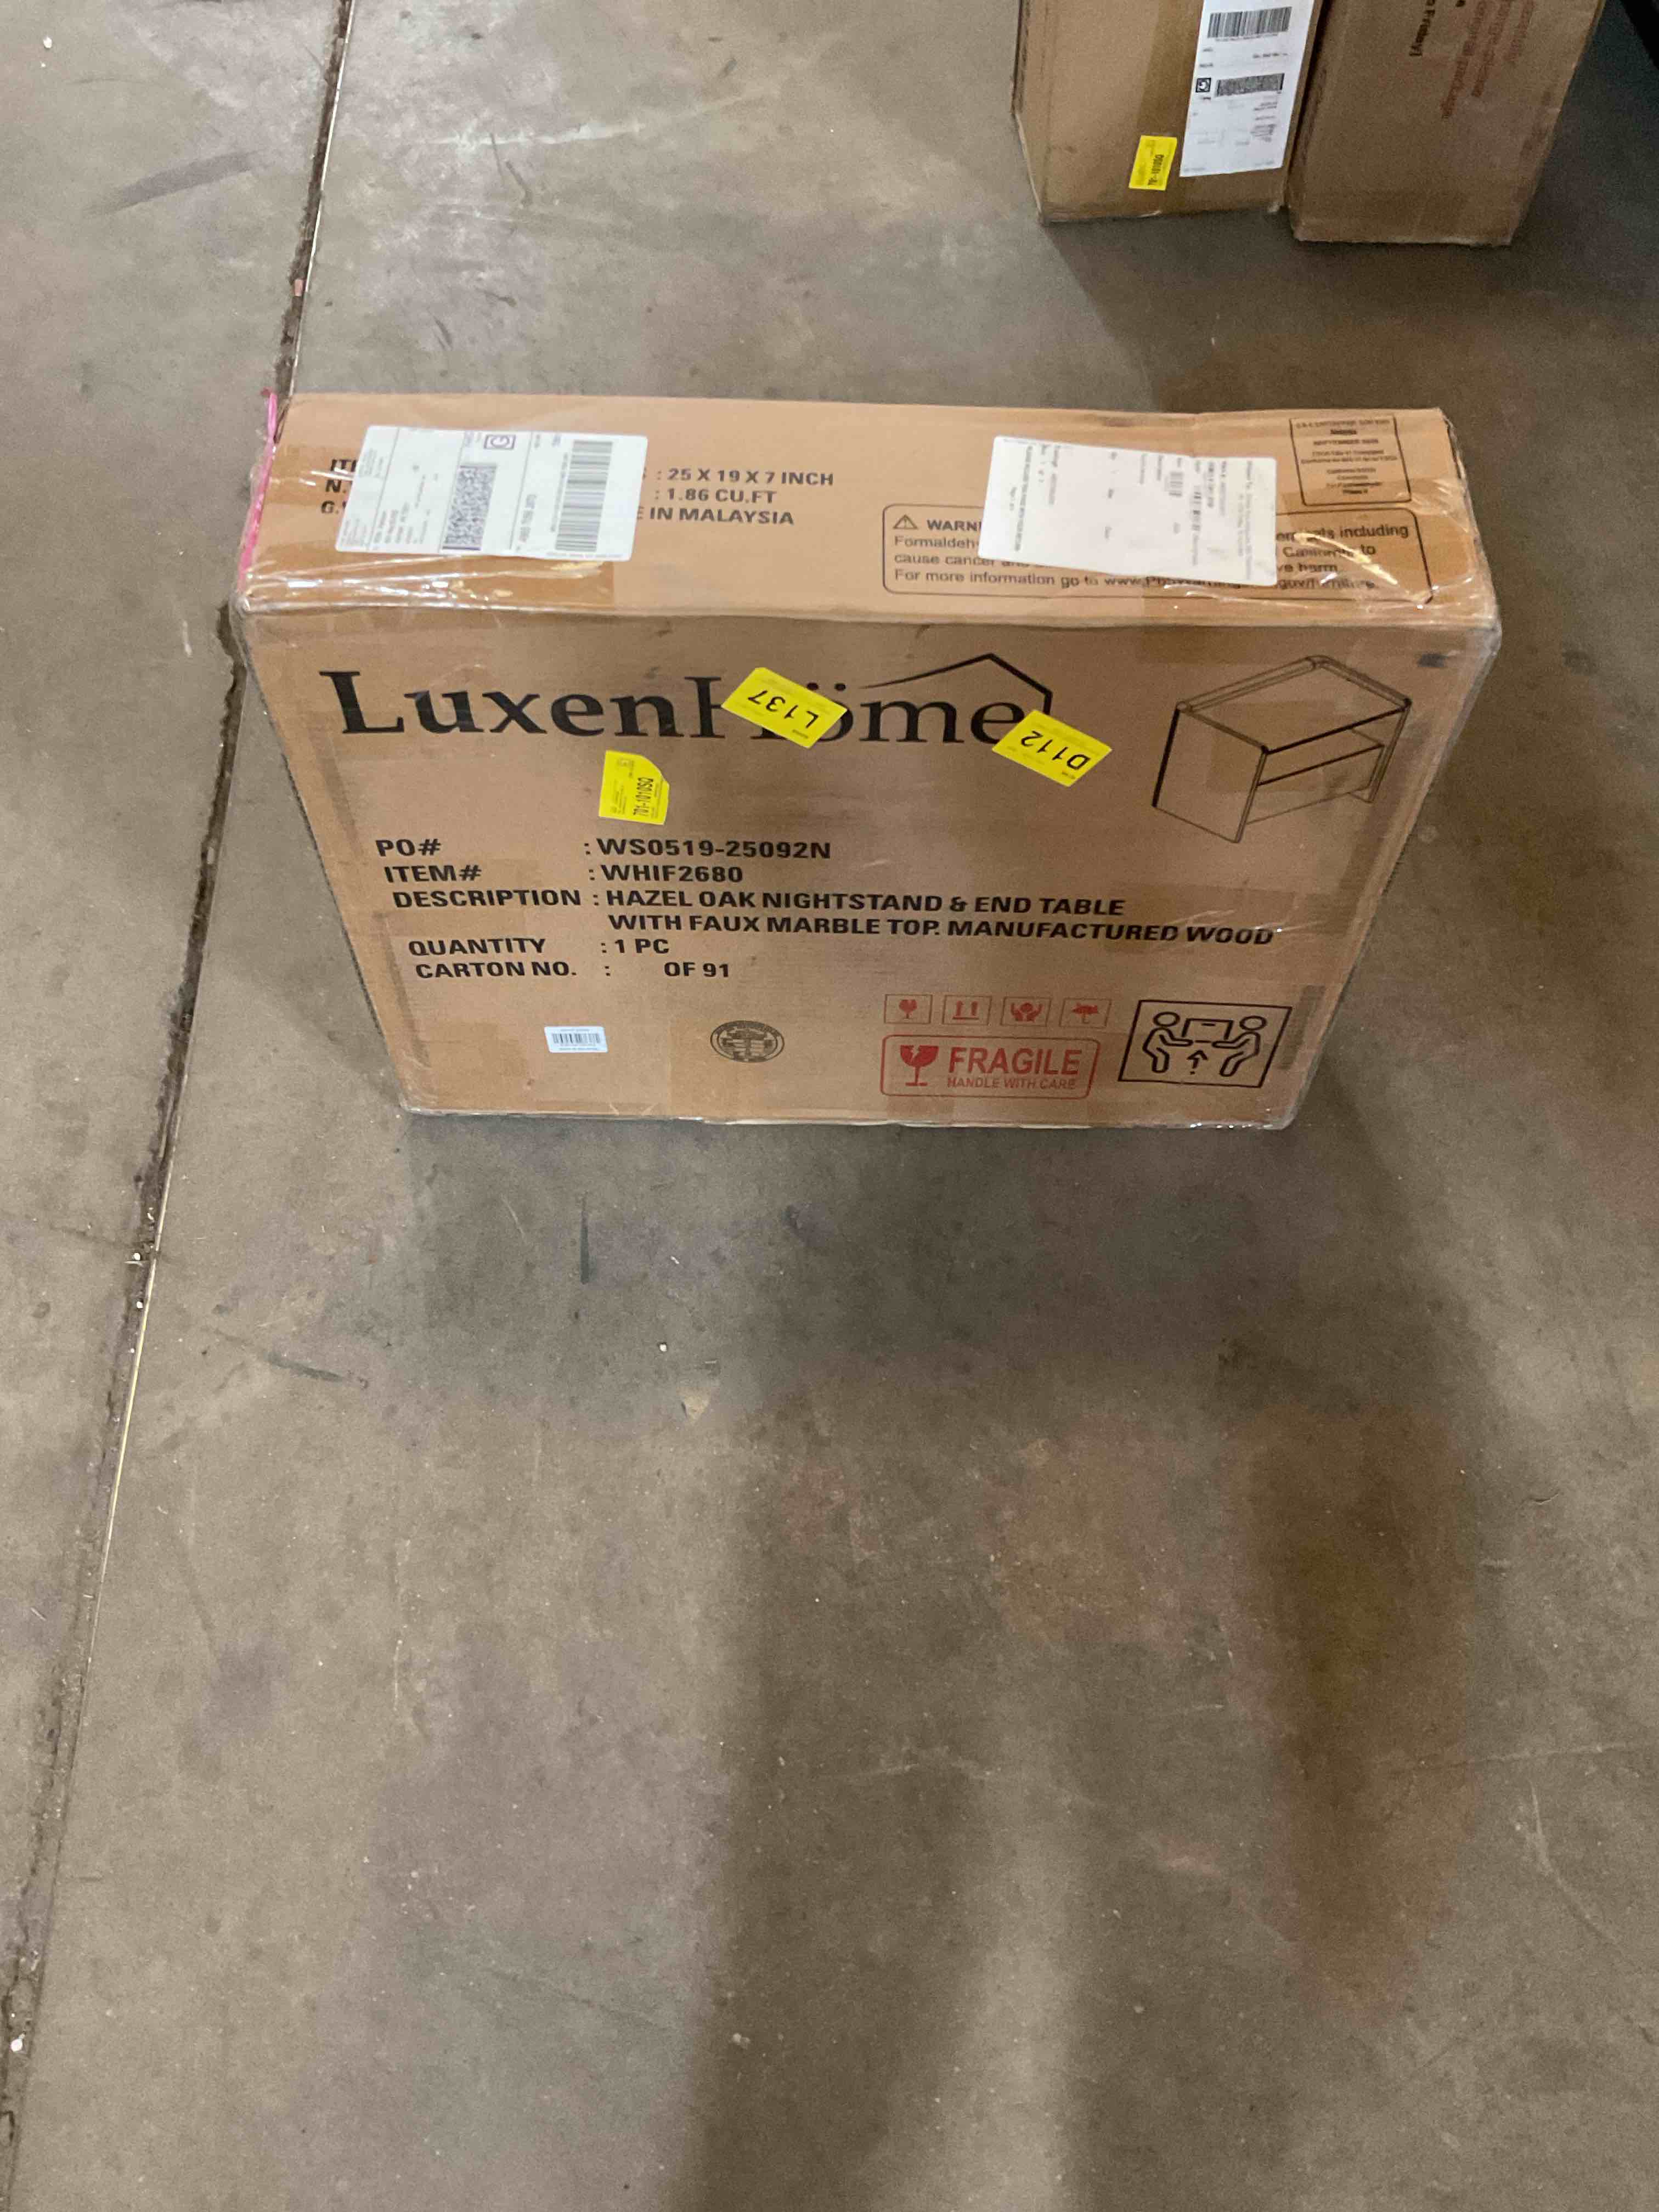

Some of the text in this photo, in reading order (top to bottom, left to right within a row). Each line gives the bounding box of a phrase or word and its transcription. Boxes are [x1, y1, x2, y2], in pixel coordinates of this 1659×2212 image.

[667, 468, 691, 481] 25
[697, 469, 710, 481] X
[718, 470, 740, 483] 19
[746, 470, 759, 483] X
[764, 471, 776, 484] 7
[781, 472, 834, 486] INCH
[667, 488, 709, 501] 1.86
[715, 488, 777, 504] CU.FT
[649, 506, 673, 521] IN
[679, 507, 795, 525] MALAYSIA
[1339, 524, 1409, 538] including
[894, 554, 940, 565] cause
[894, 568, 921, 581] For
[926, 571, 966, 583] more
[970, 571, 1054, 585] information
[1060, 576, 1081, 589] go
[747, 690, 819, 729] L137
[1020, 730, 1091, 771] D112
[375, 838, 441, 857] PO#
[596, 838, 831, 859] WS0519-25092N
[384, 864, 482, 883] ITEM#
[601, 864, 743, 883] WHIF2680
[392, 889, 582, 909] DESCRIPTION
[606, 890, 693, 906] HAZEL
[698, 891, 756, 908] OAK
[763, 893, 942, 912] NIGHTSTAND
[949, 895, 967, 912] &
[975, 896, 1031, 913] END
[1040, 898, 1126, 916] TABLE
[609, 915, 682, 931] WITH
[690, 915, 760, 932] FAUX
[768, 917, 880, 934] MARBLE
[947, 921, 1178, 942] MANUFACTURED
[1186, 926, 1273, 946] WOOD
[408, 938, 546, 956] QUANTITY
[614, 939, 625, 953] 1
[635, 939, 670, 954] PC
[415, 961, 577, 979] CARTON NO.
[664, 962, 696, 977] OF
[703, 963, 730, 978] 91
[948, 1046, 1083, 1076] FRAGILE
[947, 1076, 1077, 1091] HANDLE WITH CARE
